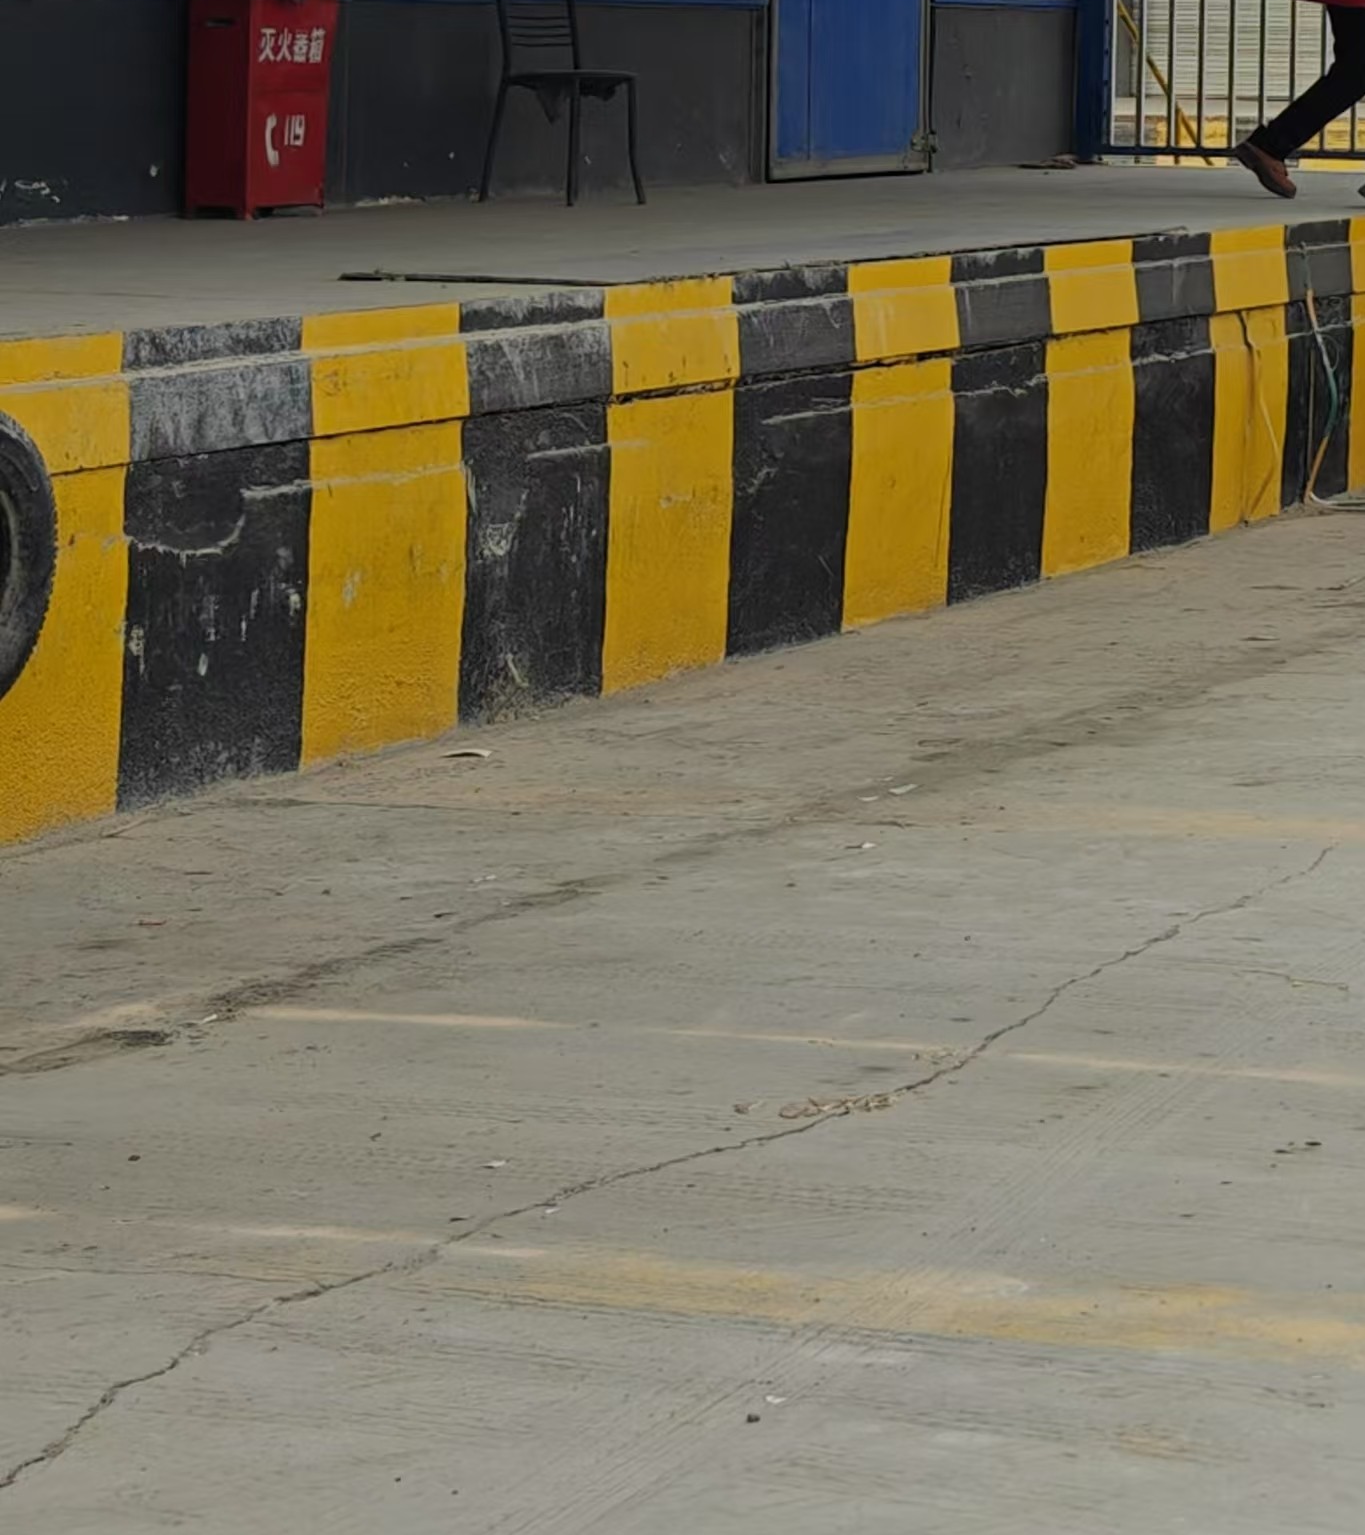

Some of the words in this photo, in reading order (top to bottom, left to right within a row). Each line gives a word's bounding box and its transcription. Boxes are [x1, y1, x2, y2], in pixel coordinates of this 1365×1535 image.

[258, 27, 325, 64] 灭火器箱
[284, 115, 306, 147] 119
